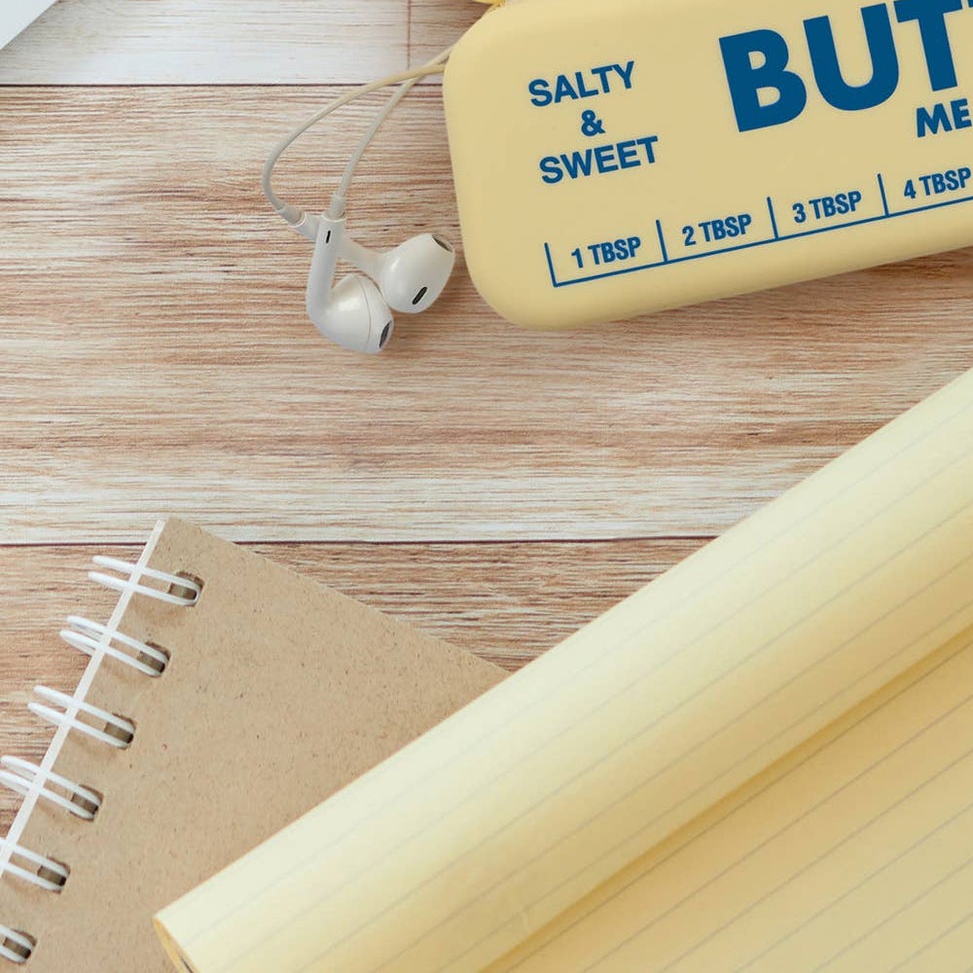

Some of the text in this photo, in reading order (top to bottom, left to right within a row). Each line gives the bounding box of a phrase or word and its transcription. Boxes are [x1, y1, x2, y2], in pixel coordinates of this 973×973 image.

[528, 61, 635, 107] SALTY
[580, 109, 606, 137] &
[916, 98, 972, 137] ME
[539, 135, 659, 184] SWEET
[904, 167, 972, 200] 4 TBSP
[792, 191, 863, 223] 3 TBSP
[682, 213, 752, 247] 2 TBSP
[571, 236, 642, 269] 1 TBSP
